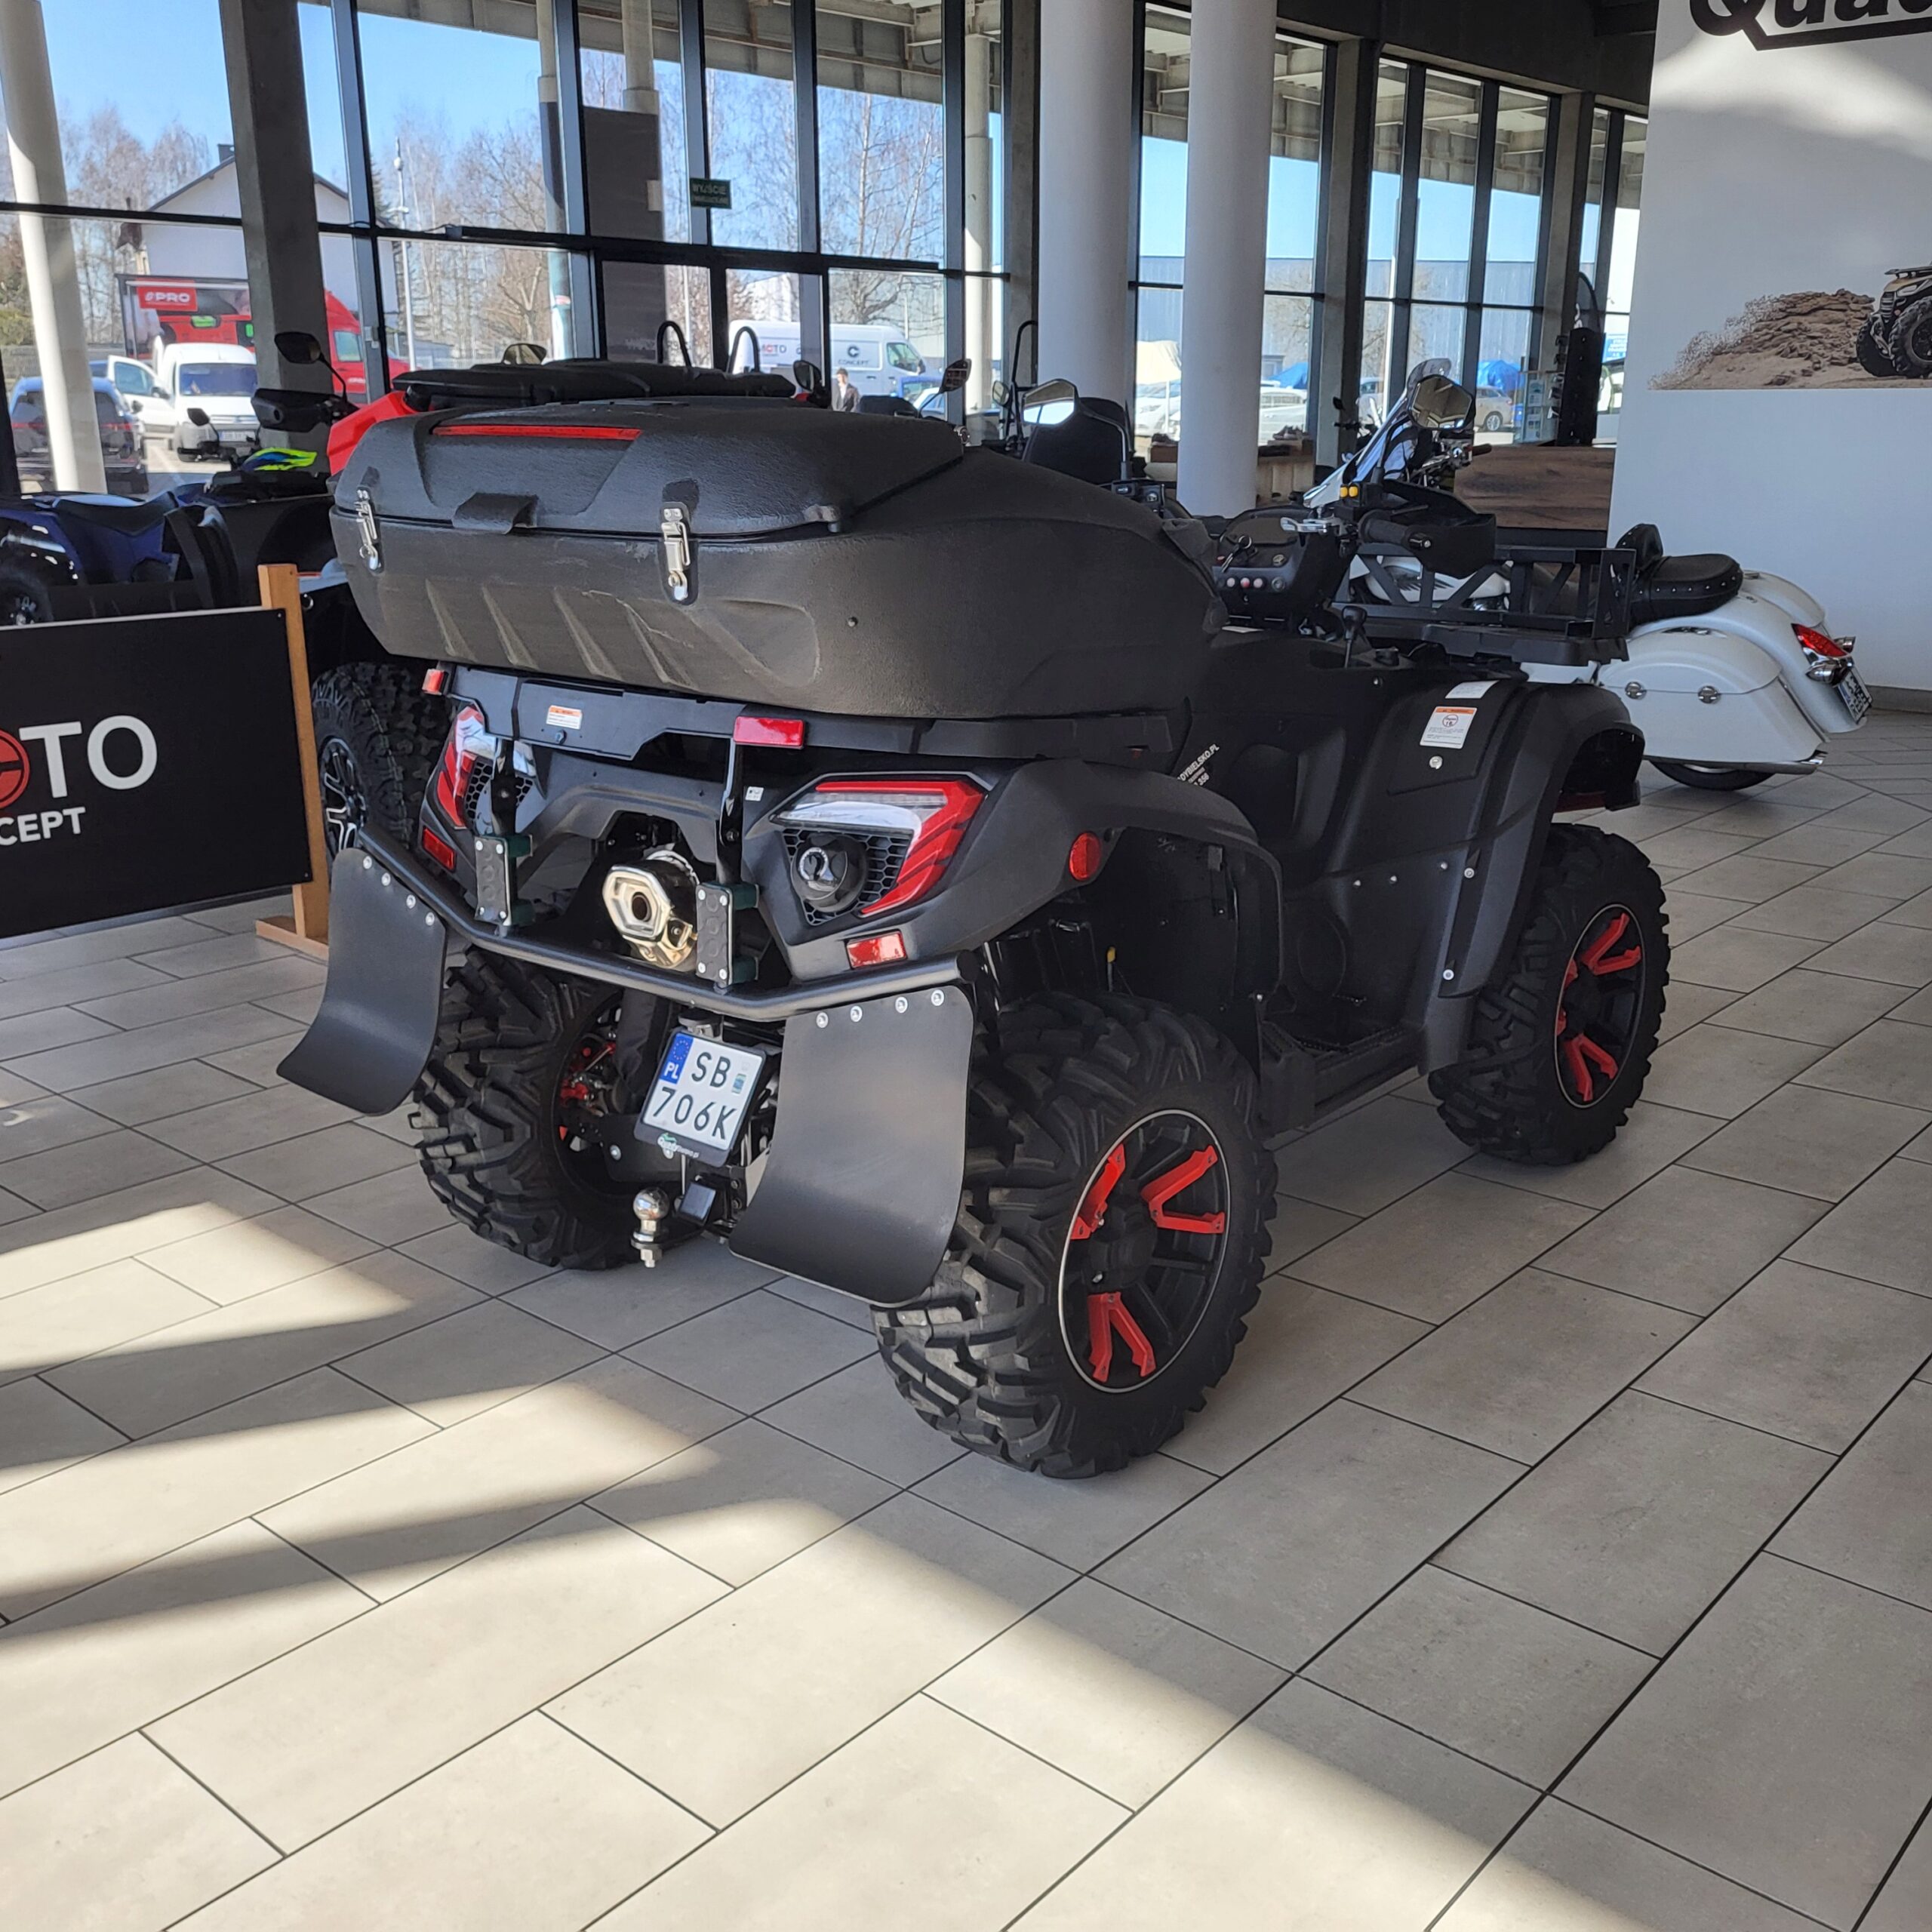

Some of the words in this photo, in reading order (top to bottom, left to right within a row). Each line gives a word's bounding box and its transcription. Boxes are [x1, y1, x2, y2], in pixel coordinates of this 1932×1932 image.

[1177, 743, 1220, 782] DYBIELSKO.PL
[663, 1062, 681, 1080] PL
[691, 1052, 731, 1088] SB
[652, 1087, 737, 1140] 706K
